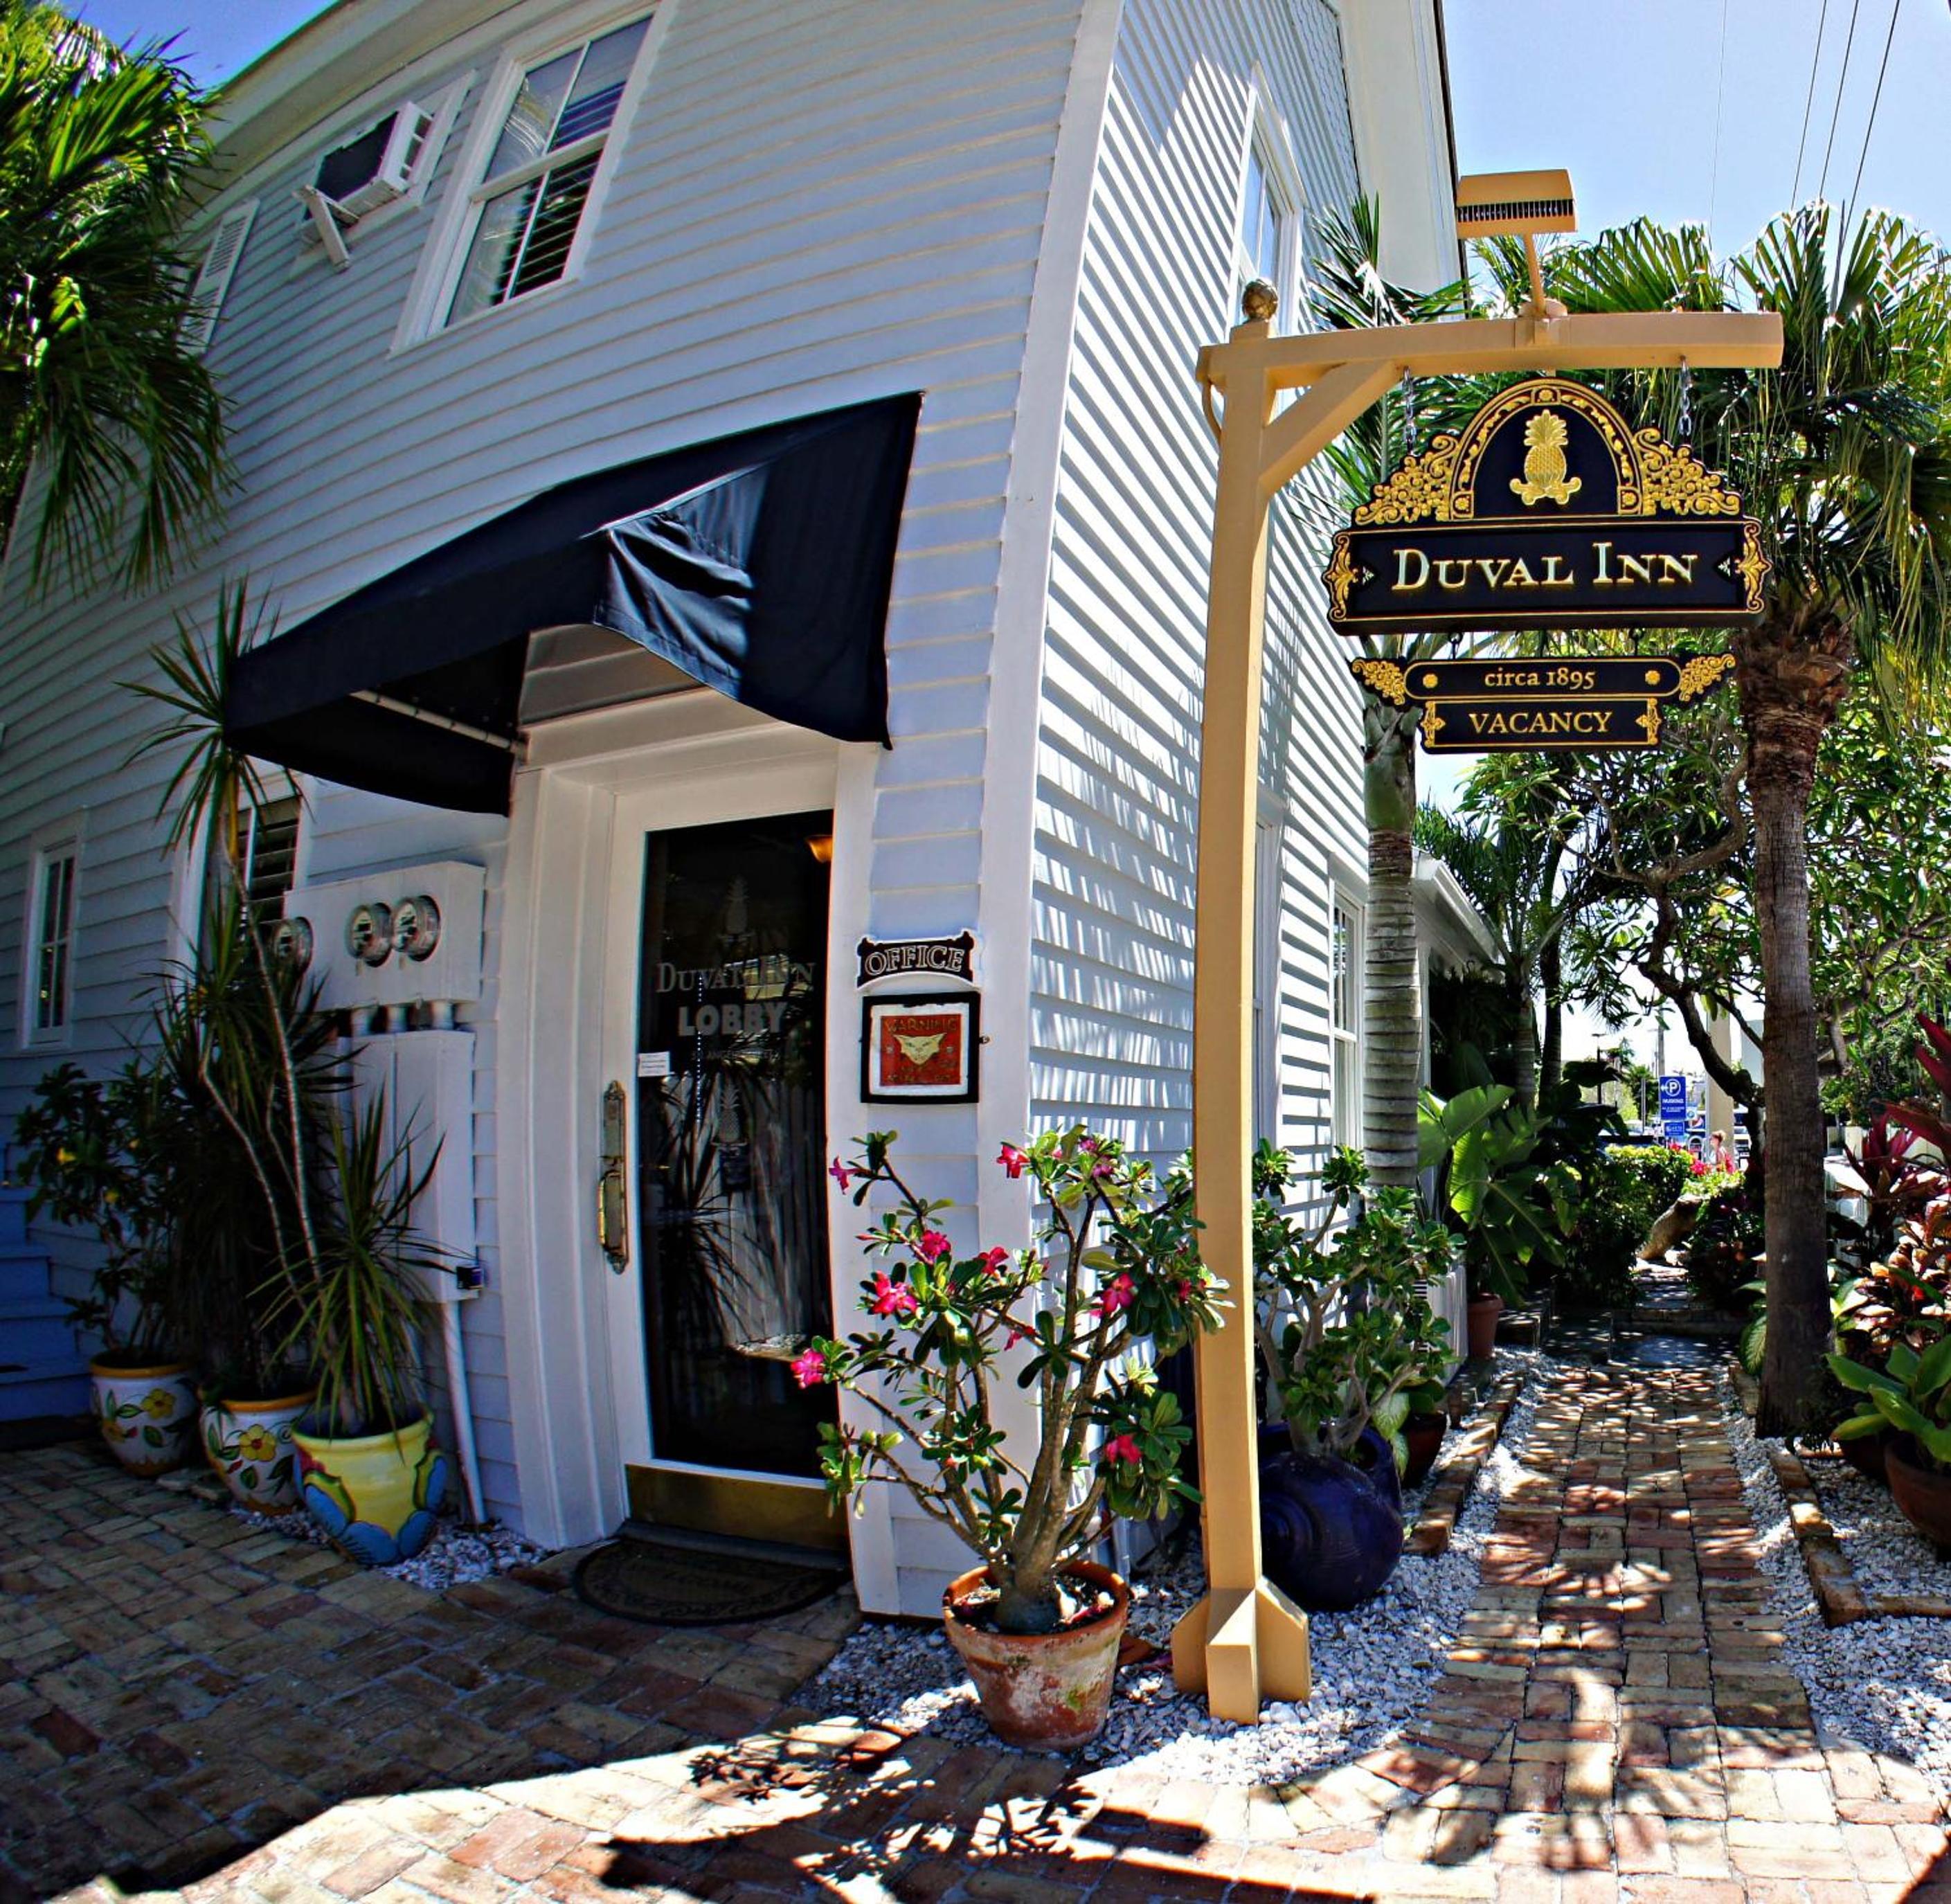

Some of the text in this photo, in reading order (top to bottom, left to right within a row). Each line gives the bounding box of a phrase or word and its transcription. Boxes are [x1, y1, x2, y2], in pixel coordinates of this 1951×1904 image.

[1392, 541, 1698, 591] DUVAL INN
[1484, 667, 1595, 690] circa 1895
[1468, 711, 1612, 734] VACANCY
[865, 944, 965, 976] OFFICE
[678, 1002, 789, 1036] LOBBY
